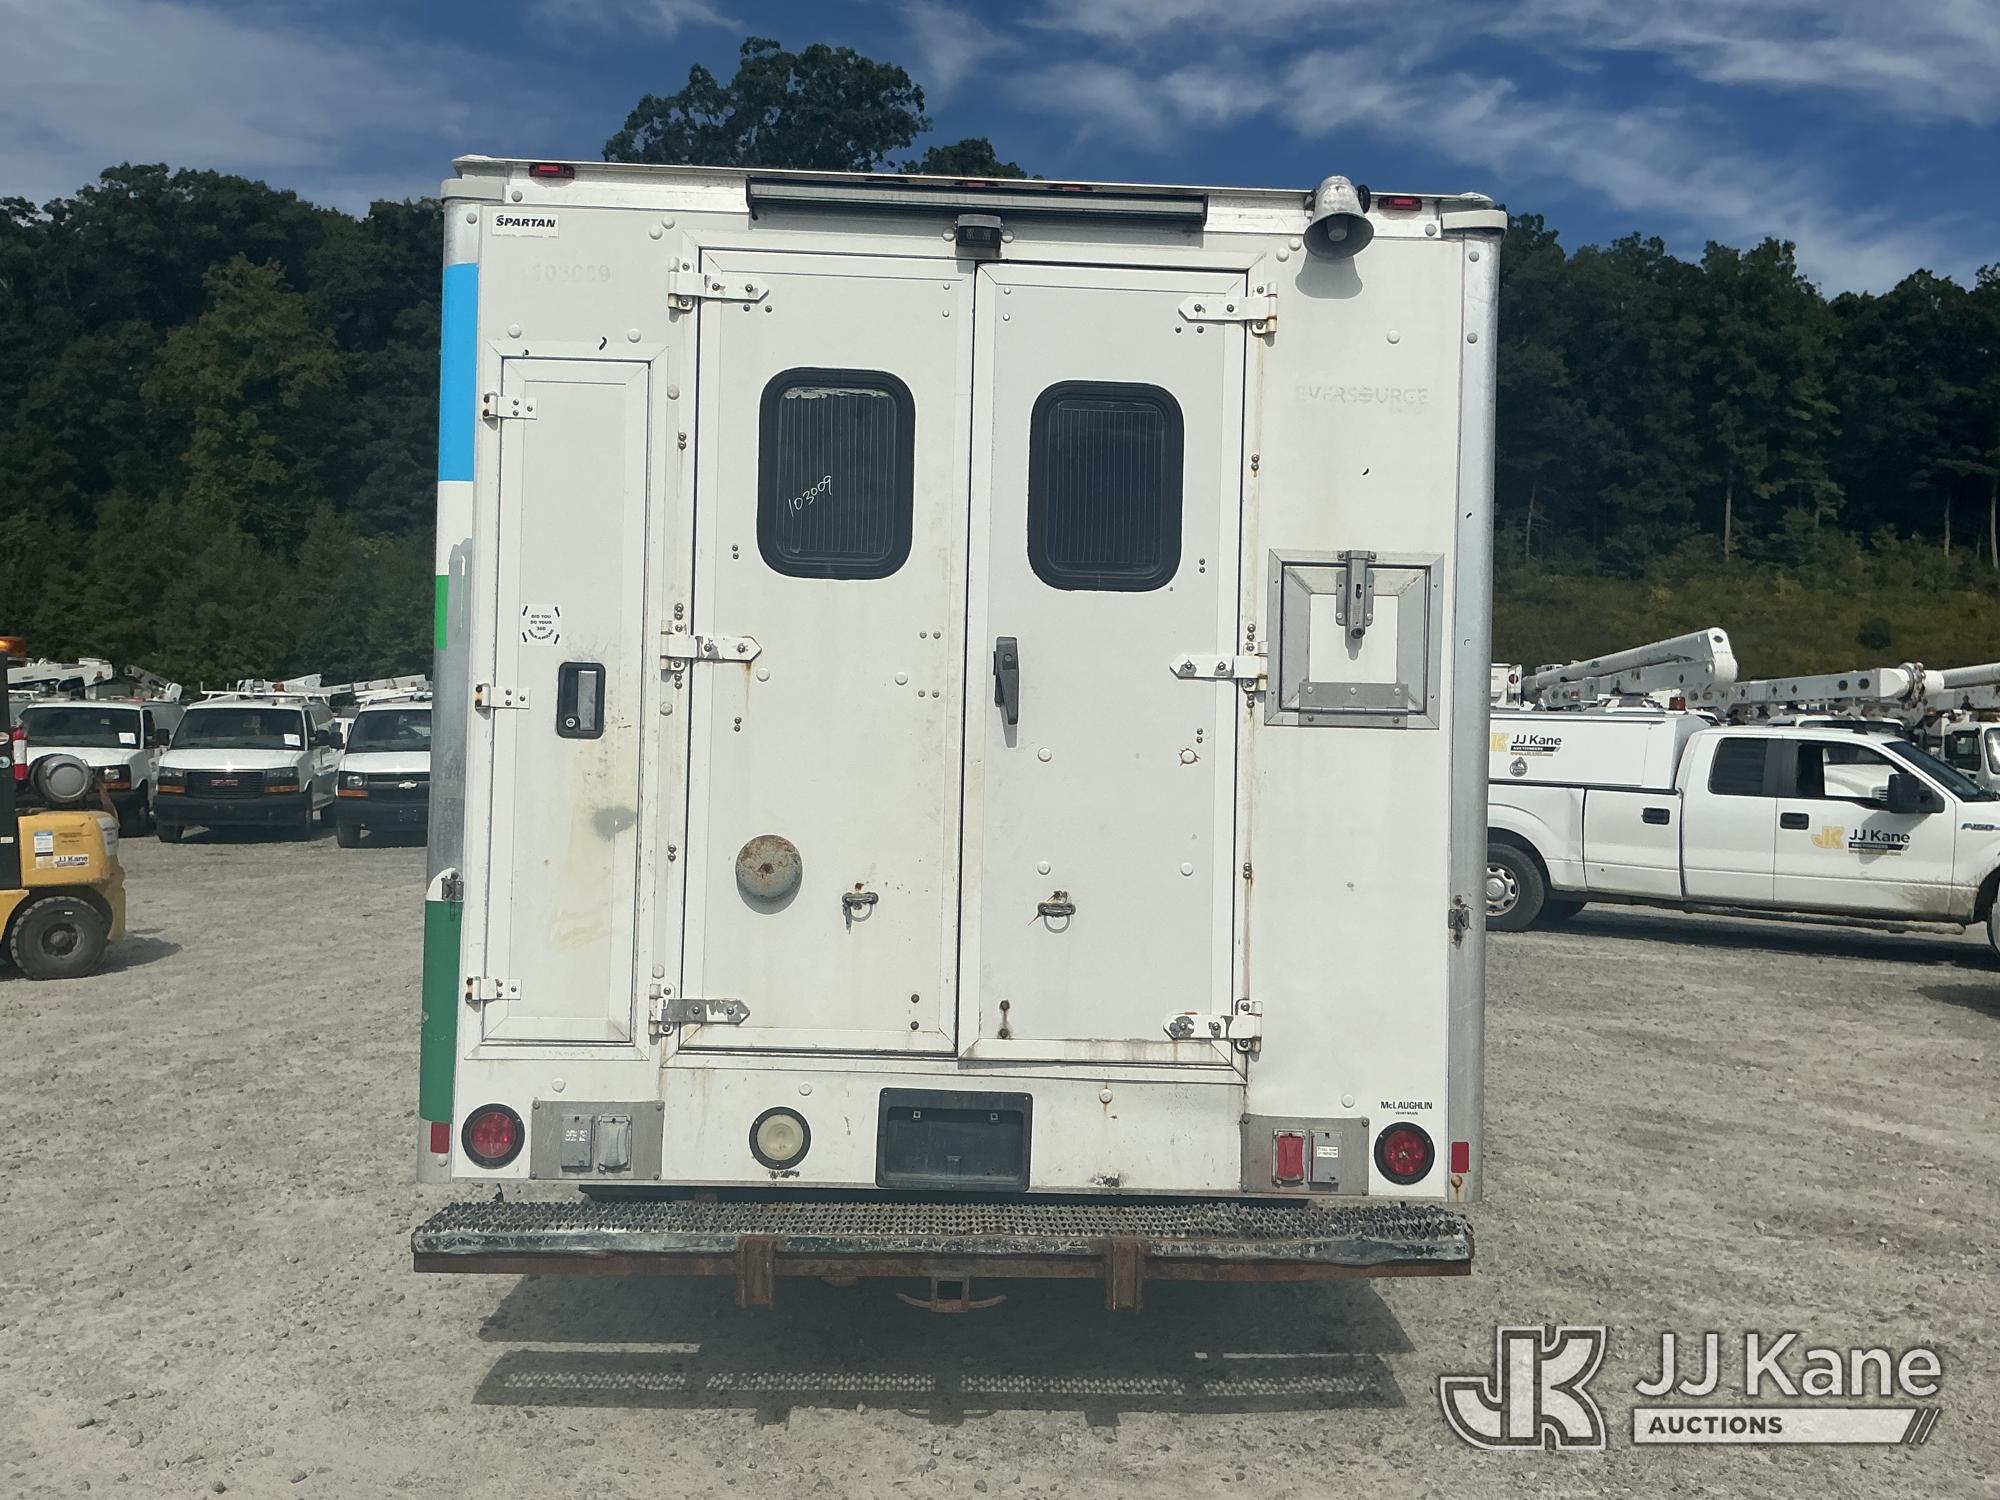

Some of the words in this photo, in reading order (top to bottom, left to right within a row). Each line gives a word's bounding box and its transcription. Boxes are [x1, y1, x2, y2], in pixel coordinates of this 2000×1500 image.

[495, 215, 556, 228] SPARTAN
[788, 475, 832, 517] 103009
[1512, 734, 1526, 744] JJ
[1529, 735, 1562, 745] Kane
[1849, 829, 1866, 840] JJ
[1870, 829, 1910, 843] Kane
[1380, 1101, 1433, 1110] McLAUGHLIN
